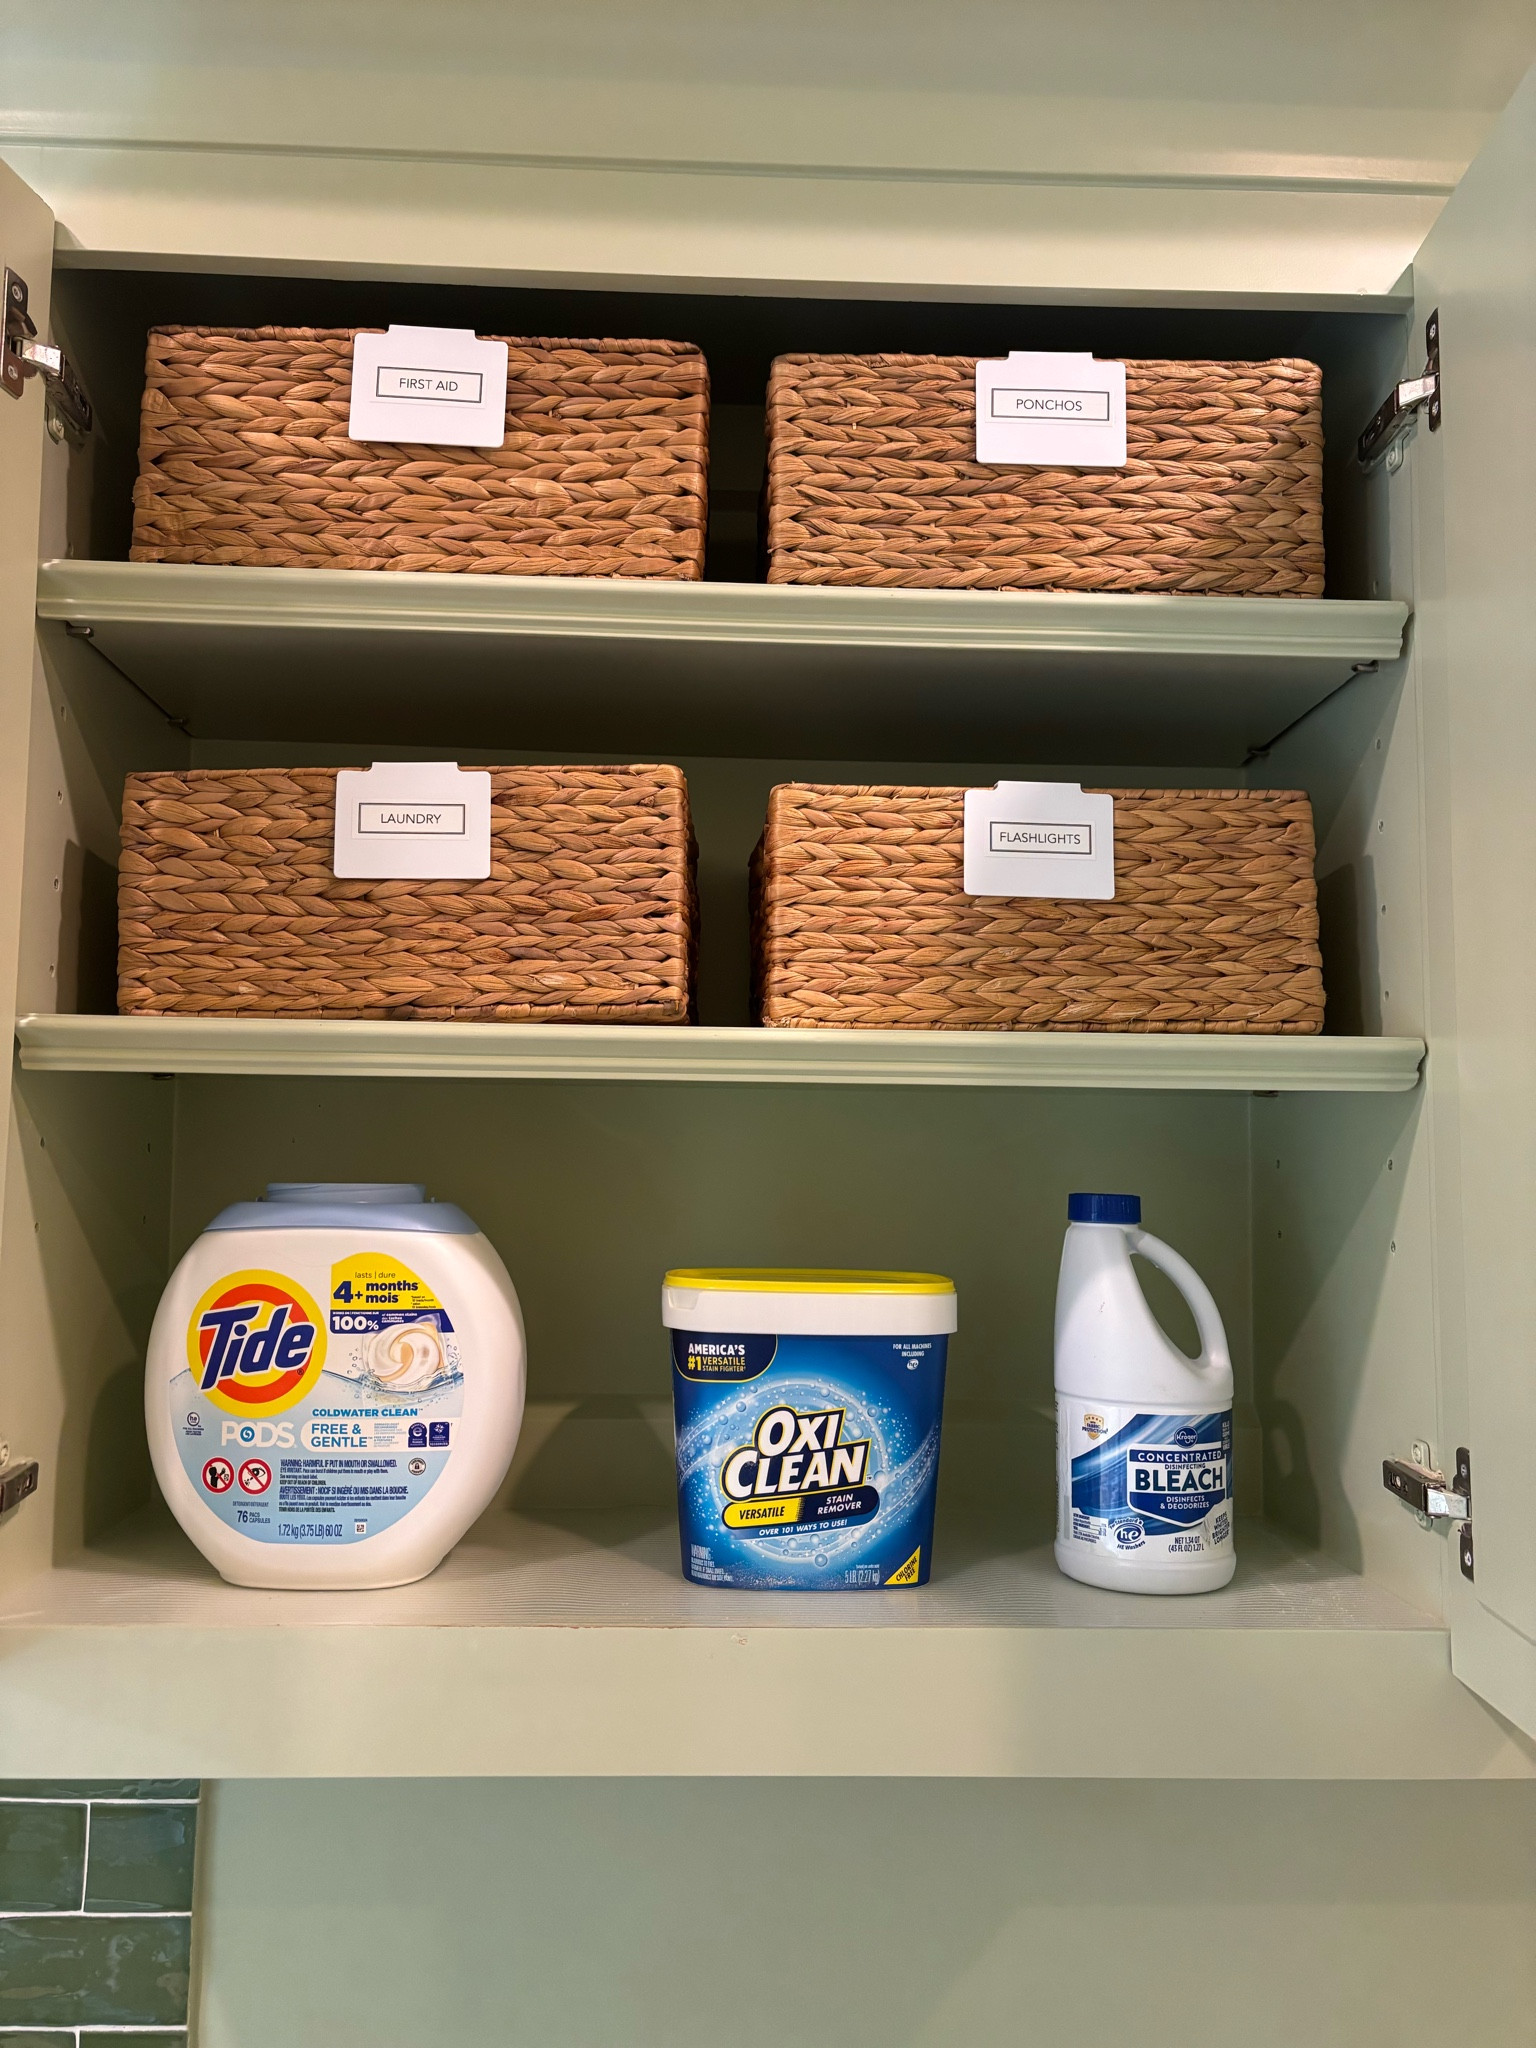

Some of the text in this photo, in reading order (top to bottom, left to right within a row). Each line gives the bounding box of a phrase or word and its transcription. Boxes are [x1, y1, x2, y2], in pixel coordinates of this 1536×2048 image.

[399, 377, 459, 392] FIRST AID
[1016, 398, 1083, 412] PONCHOS
[380, 813, 442, 824] LAUNDRY
[999, 831, 1081, 845] FLASHLIGHTS
[354, 1271, 396, 1279] lasts dure
[365, 1280, 419, 1292] months
[365, 1292, 399, 1304] mois
[332, 1315, 379, 1331] 100%
[198, 1304, 316, 1391] Tide
[688, 1343, 746, 1356] AMERICA'S
[911, 1342, 932, 1350] MACHINES
[687, 1355, 702, 1371] #1
[702, 1356, 746, 1366] VERSATILE
[312, 1408, 418, 1418] COLDWATER CLEAN
[221, 1420, 295, 1449] PODS
[311, 1423, 348, 1435] FREE
[351, 1423, 362, 1435] &
[757, 1410, 840, 1457] OXI
[1176, 1430, 1197, 1444] Kroger
[1137, 1450, 1222, 1462] CONCENTRATED
[303, 1459, 324, 1468] HARMFUL
[330, 1459, 338, 1468] PUT
[344, 1459, 360, 1468] MOUTH
[361, 1459, 367, 1468] OR
[368, 1459, 398, 1468] SWALLOWED.
[1164, 1462, 1206, 1470] DISINFECTING
[724, 1444, 866, 1498] CLEAN
[1135, 1466, 1223, 1492] BLEACH
[826, 1494, 854, 1505] STAIN
[1166, 1495, 1205, 1503] DISINFECTS
[1167, 1501, 1210, 1510] DEODORIZES
[739, 1506, 785, 1520] VERSATILE
[817, 1502, 862, 1514] REMOVER
[237, 1510, 248, 1523] 76
[278, 1524, 343, 1540] 1.72 kg (3.75 LB) 60 OZ
[758, 1519, 848, 1536] OVER 101 WAYS TO USE!
[1174, 1536, 1184, 1545] NET
[1184, 1536, 1194, 1544] 1.34
[1168, 1545, 1178, 1553] (43
[895, 1556, 918, 1582] CHLORINE
[904, 1568, 916, 1582] FREE
[844, 1570, 849, 1584] 5
